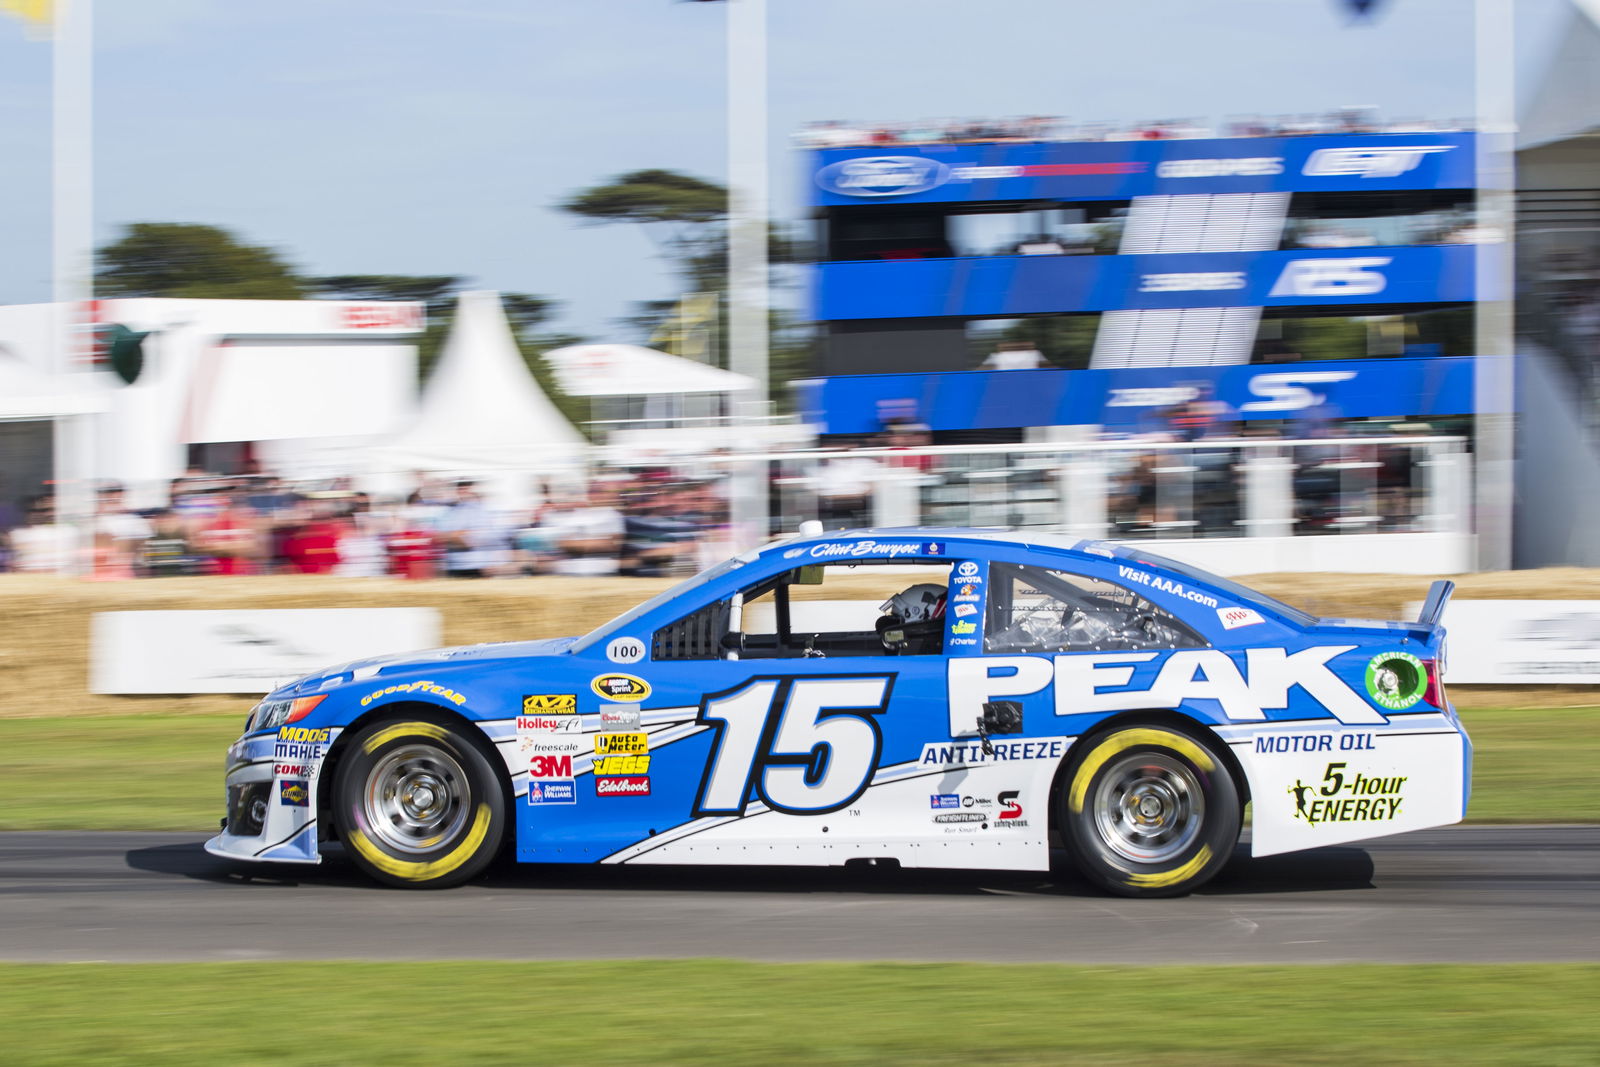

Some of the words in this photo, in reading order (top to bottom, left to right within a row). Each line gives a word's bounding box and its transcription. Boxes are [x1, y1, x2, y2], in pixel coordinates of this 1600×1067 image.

[810, 543, 852, 557] Clint
[851, 541, 919, 558] Bowyer
[953, 575, 982, 584] TOYOTA
[1119, 565, 1150, 585] Visit
[1151, 577, 1218, 608] AAA.com
[613, 646, 637, 658] 100
[1369, 651, 1423, 672] AMERICAN
[360, 680, 467, 706] GOODYEAR
[611, 685, 631, 693] Sprint
[948, 645, 1390, 738] PEAK
[1373, 691, 1423, 709] ETHANOL
[517, 718, 557, 732] Holley
[278, 726, 330, 743] MOOG
[610, 735, 638, 743] Auto
[274, 743, 320, 759] MAHLE
[534, 743, 578, 751] freescale
[608, 743, 645, 752] Meter
[690, 672, 899, 816] 15
[1255, 735, 1332, 754] MOTOR
[1340, 733, 1376, 750] OIL
[923, 741, 1062, 765] ANTIREEZE
[274, 764, 306, 775] COMP
[530, 755, 572, 777] 3M
[594, 755, 651, 775] JEGS
[597, 779, 649, 794] Edelbrock
[1320, 762, 1408, 797] 5-hour
[849, 809, 861, 817] TM
[936, 814, 986, 823] FREIGHTLINER
[1308, 797, 1403, 823] ENERGY
